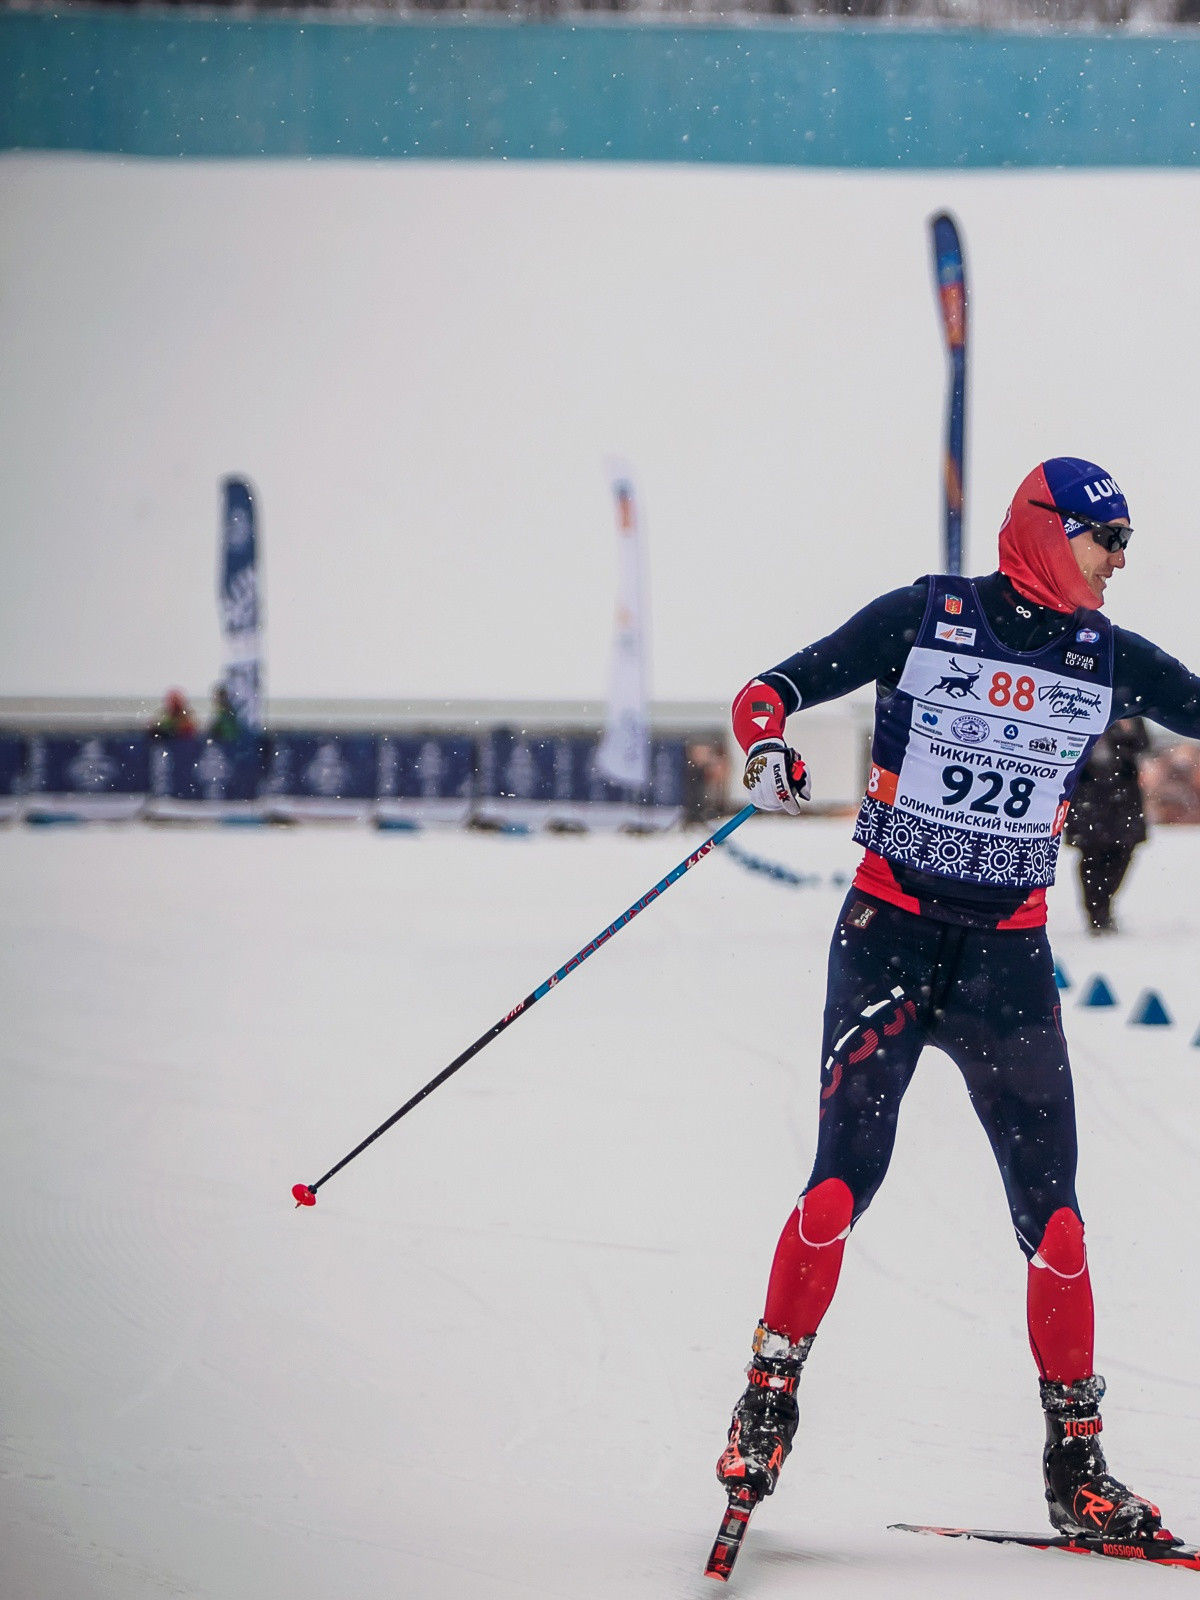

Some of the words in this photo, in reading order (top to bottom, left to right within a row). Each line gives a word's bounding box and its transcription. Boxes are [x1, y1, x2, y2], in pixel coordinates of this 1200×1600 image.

[988, 671, 1036, 712] 88
[1039, 681, 1101, 713] Праздник
[1051, 700, 1091, 723] Севера
[929, 742, 994, 769] НИКИТА
[996, 758, 1059, 780] КРЮКОВ
[941, 764, 1037, 819] 928
[899, 794, 1002, 831] ОЛИМПИЙСКИЙ
[1004, 821, 1051, 834] ЧЕМПИОН
[1102, 1543, 1148, 1560] ROSSIGNOL
